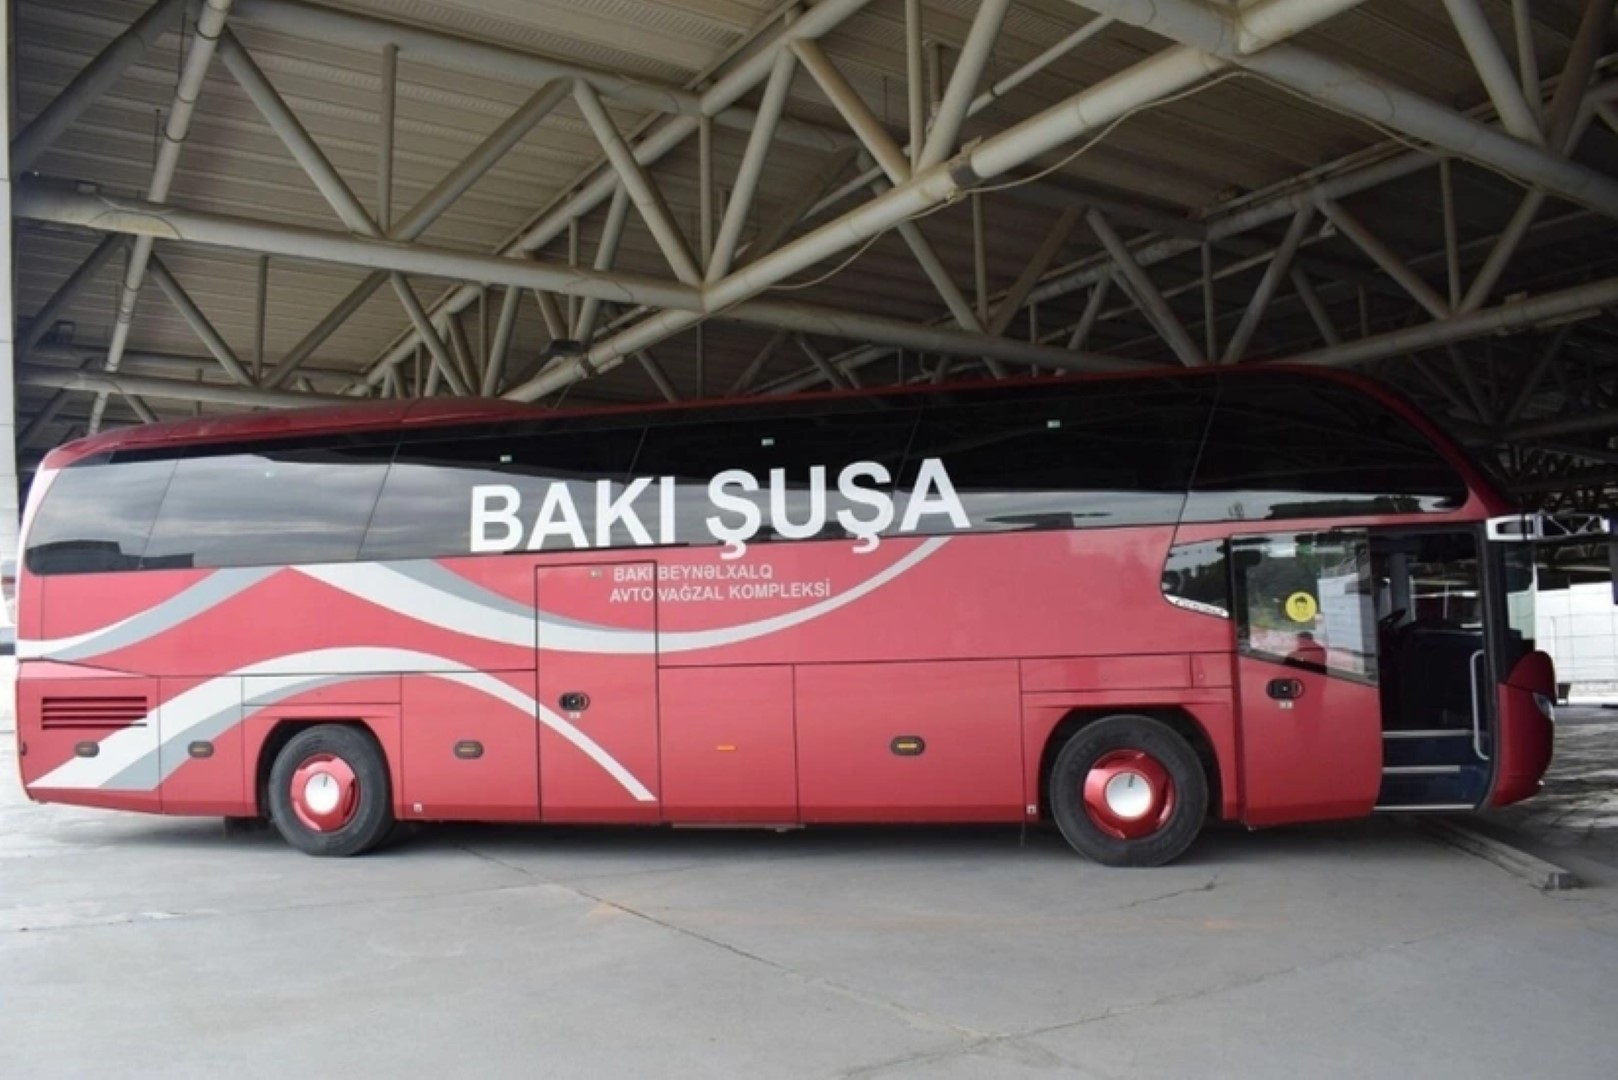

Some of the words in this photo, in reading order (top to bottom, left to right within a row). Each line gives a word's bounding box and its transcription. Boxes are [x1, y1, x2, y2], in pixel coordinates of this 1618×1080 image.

[469, 476, 676, 552] BAKI
[706, 458, 972, 560] ŞUŞA
[613, 566, 653, 582] BAKI
[658, 564, 773, 580] BEYNƏLXALQ
[609, 587, 654, 603] AVTO
[657, 583, 724, 602] VAĞZAL
[729, 578, 831, 599] KOMPLEKSİ
